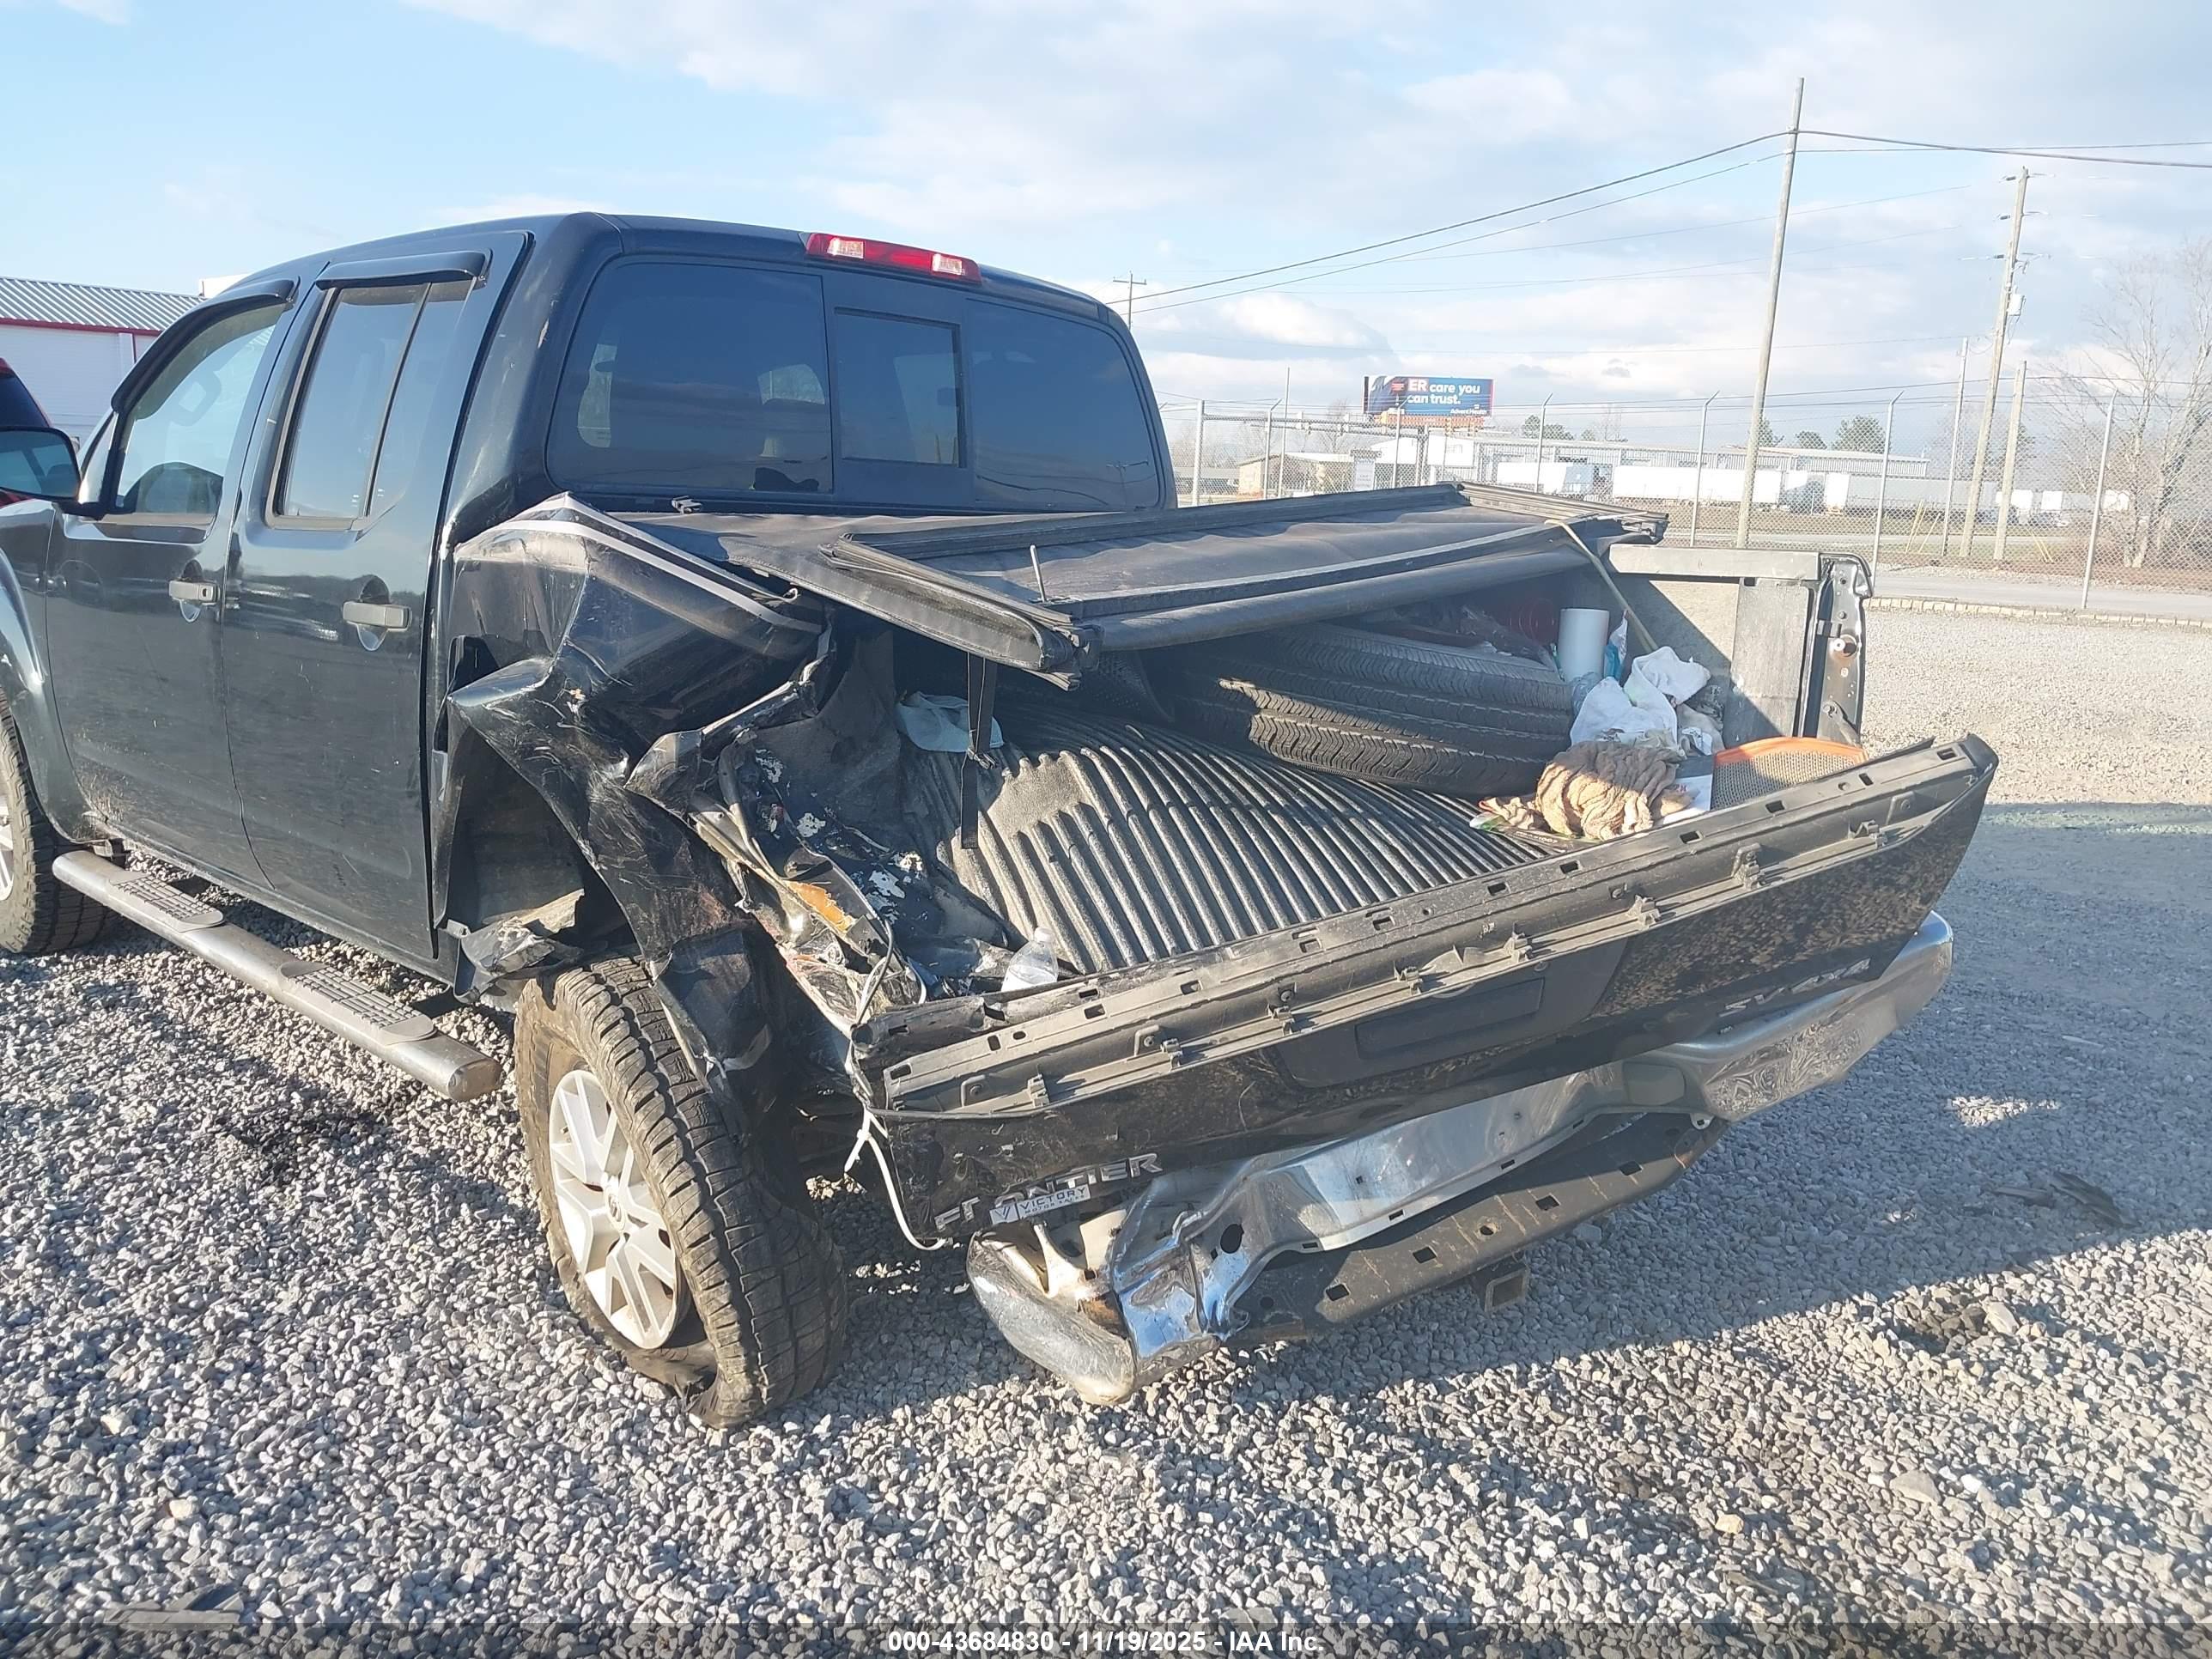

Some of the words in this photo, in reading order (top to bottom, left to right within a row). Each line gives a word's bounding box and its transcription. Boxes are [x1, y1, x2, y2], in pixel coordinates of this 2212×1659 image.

[1409, 379, 1427, 392] ER
[1430, 384, 1455, 393] care
[1459, 384, 1480, 396] you
[1430, 395, 1462, 404] trust.
[1019, 1187, 1086, 1210] VICTORY
[1024, 1202, 1055, 1214] MOTOR
